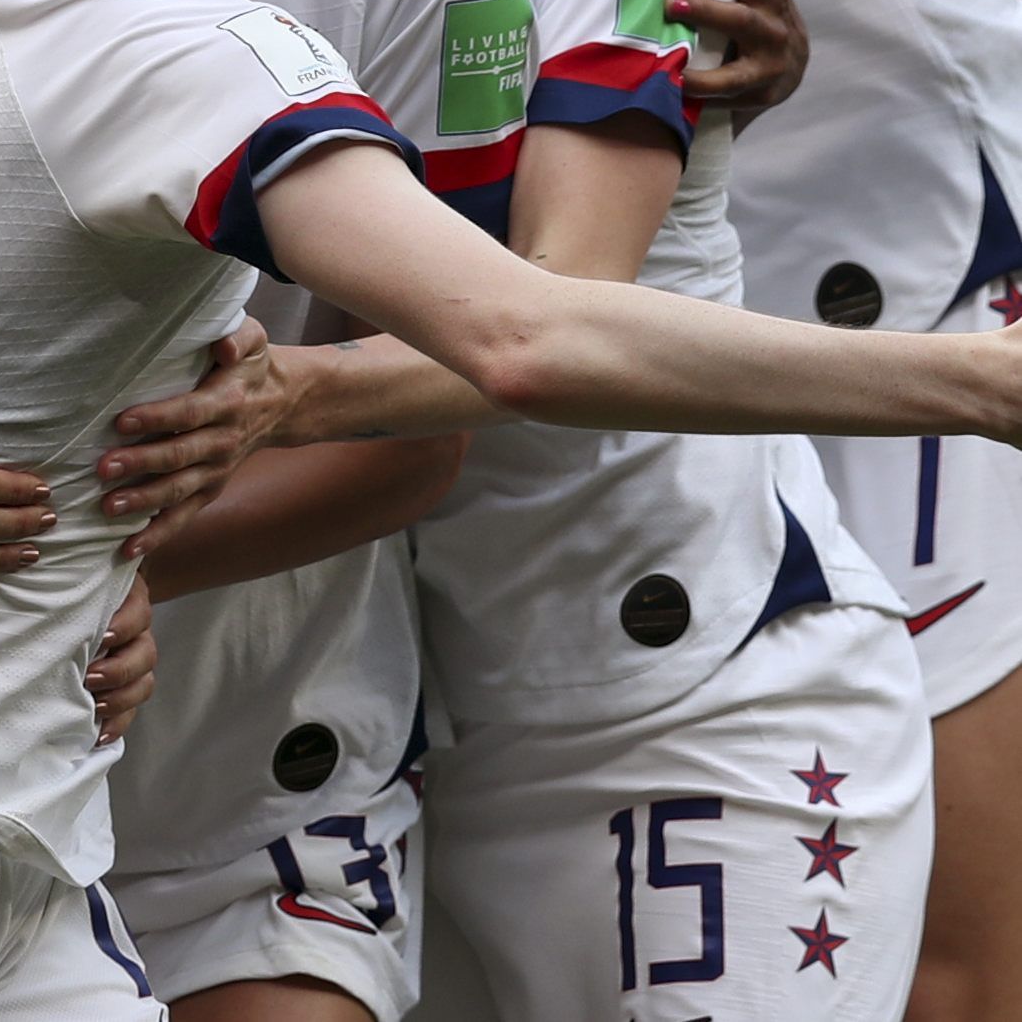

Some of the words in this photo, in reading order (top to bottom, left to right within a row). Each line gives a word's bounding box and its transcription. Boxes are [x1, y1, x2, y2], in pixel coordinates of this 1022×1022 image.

[452, 25, 528, 51] LIVING
[267, 814, 396, 929] 13
[609, 797, 724, 992] 15
